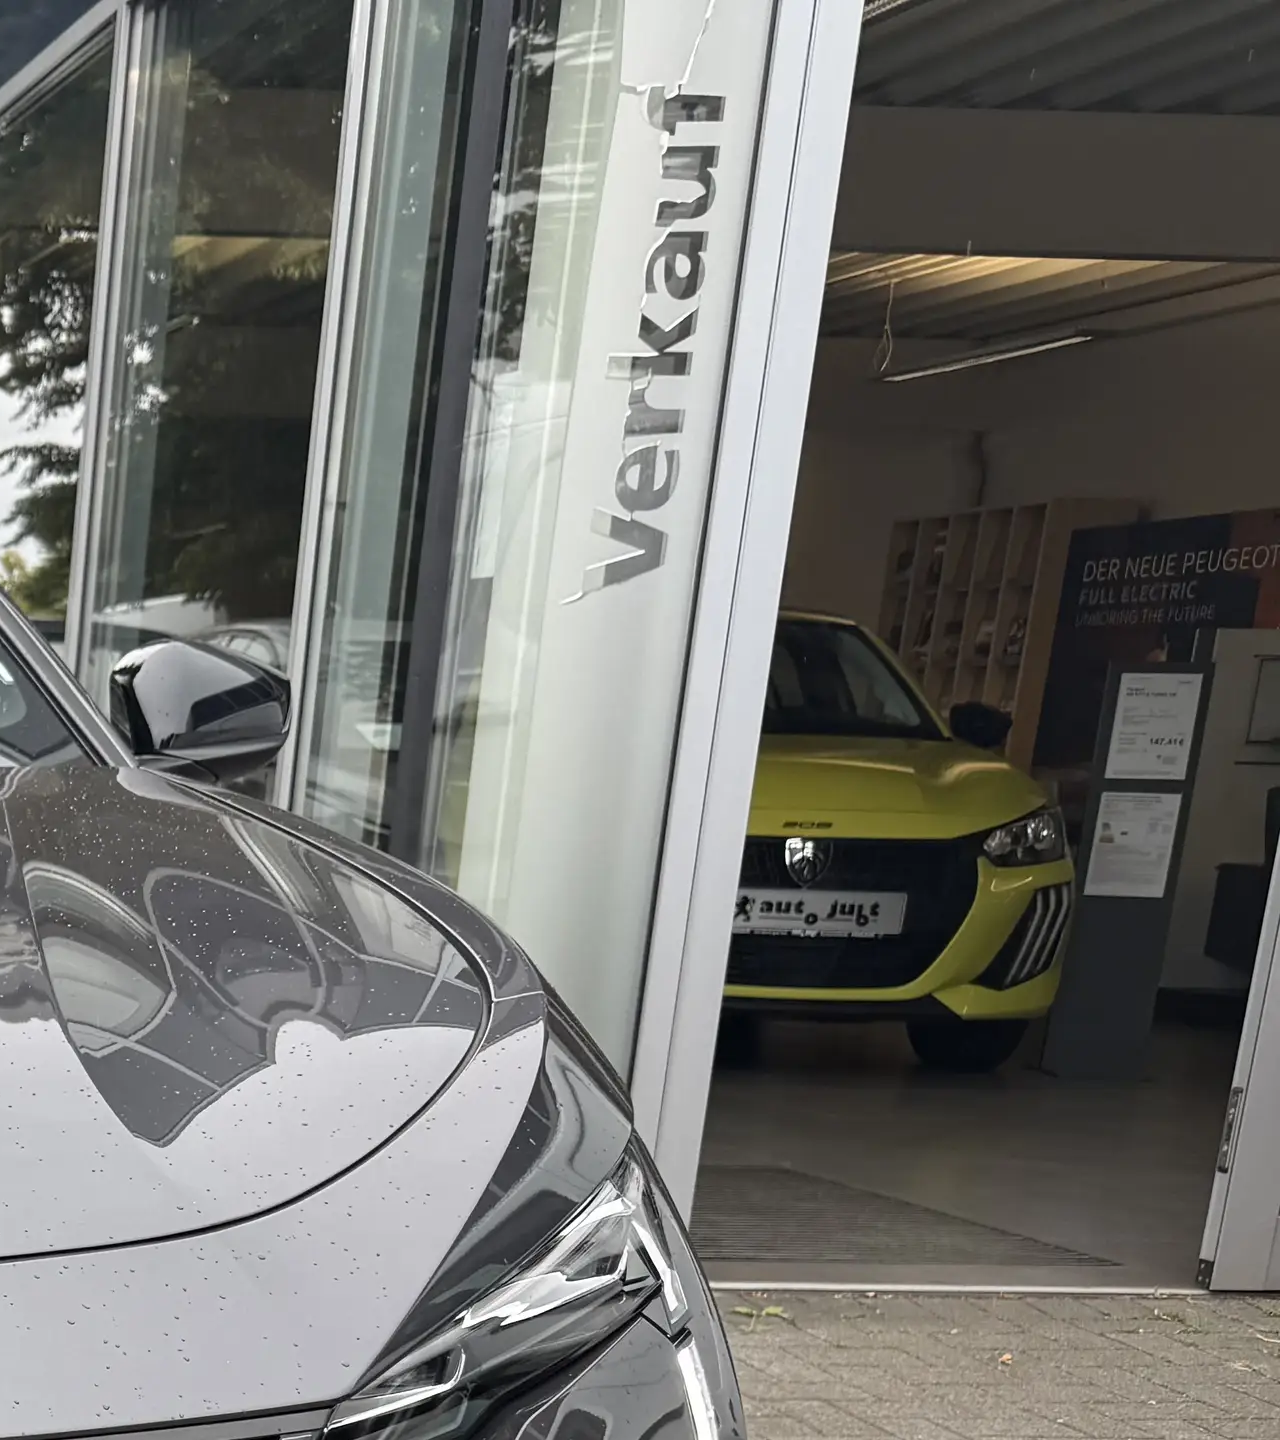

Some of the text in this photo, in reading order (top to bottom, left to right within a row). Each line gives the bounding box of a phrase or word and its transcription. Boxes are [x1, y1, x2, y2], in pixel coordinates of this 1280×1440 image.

[583, 85, 726, 594] Verkauf
[1083, 544, 1280, 582] DER NEUE PEUGEOT
[1078, 580, 1198, 605] FULL ELECTRIC
[1140, 607, 1164, 624] THE
[1167, 604, 1216, 621] FUTURE
